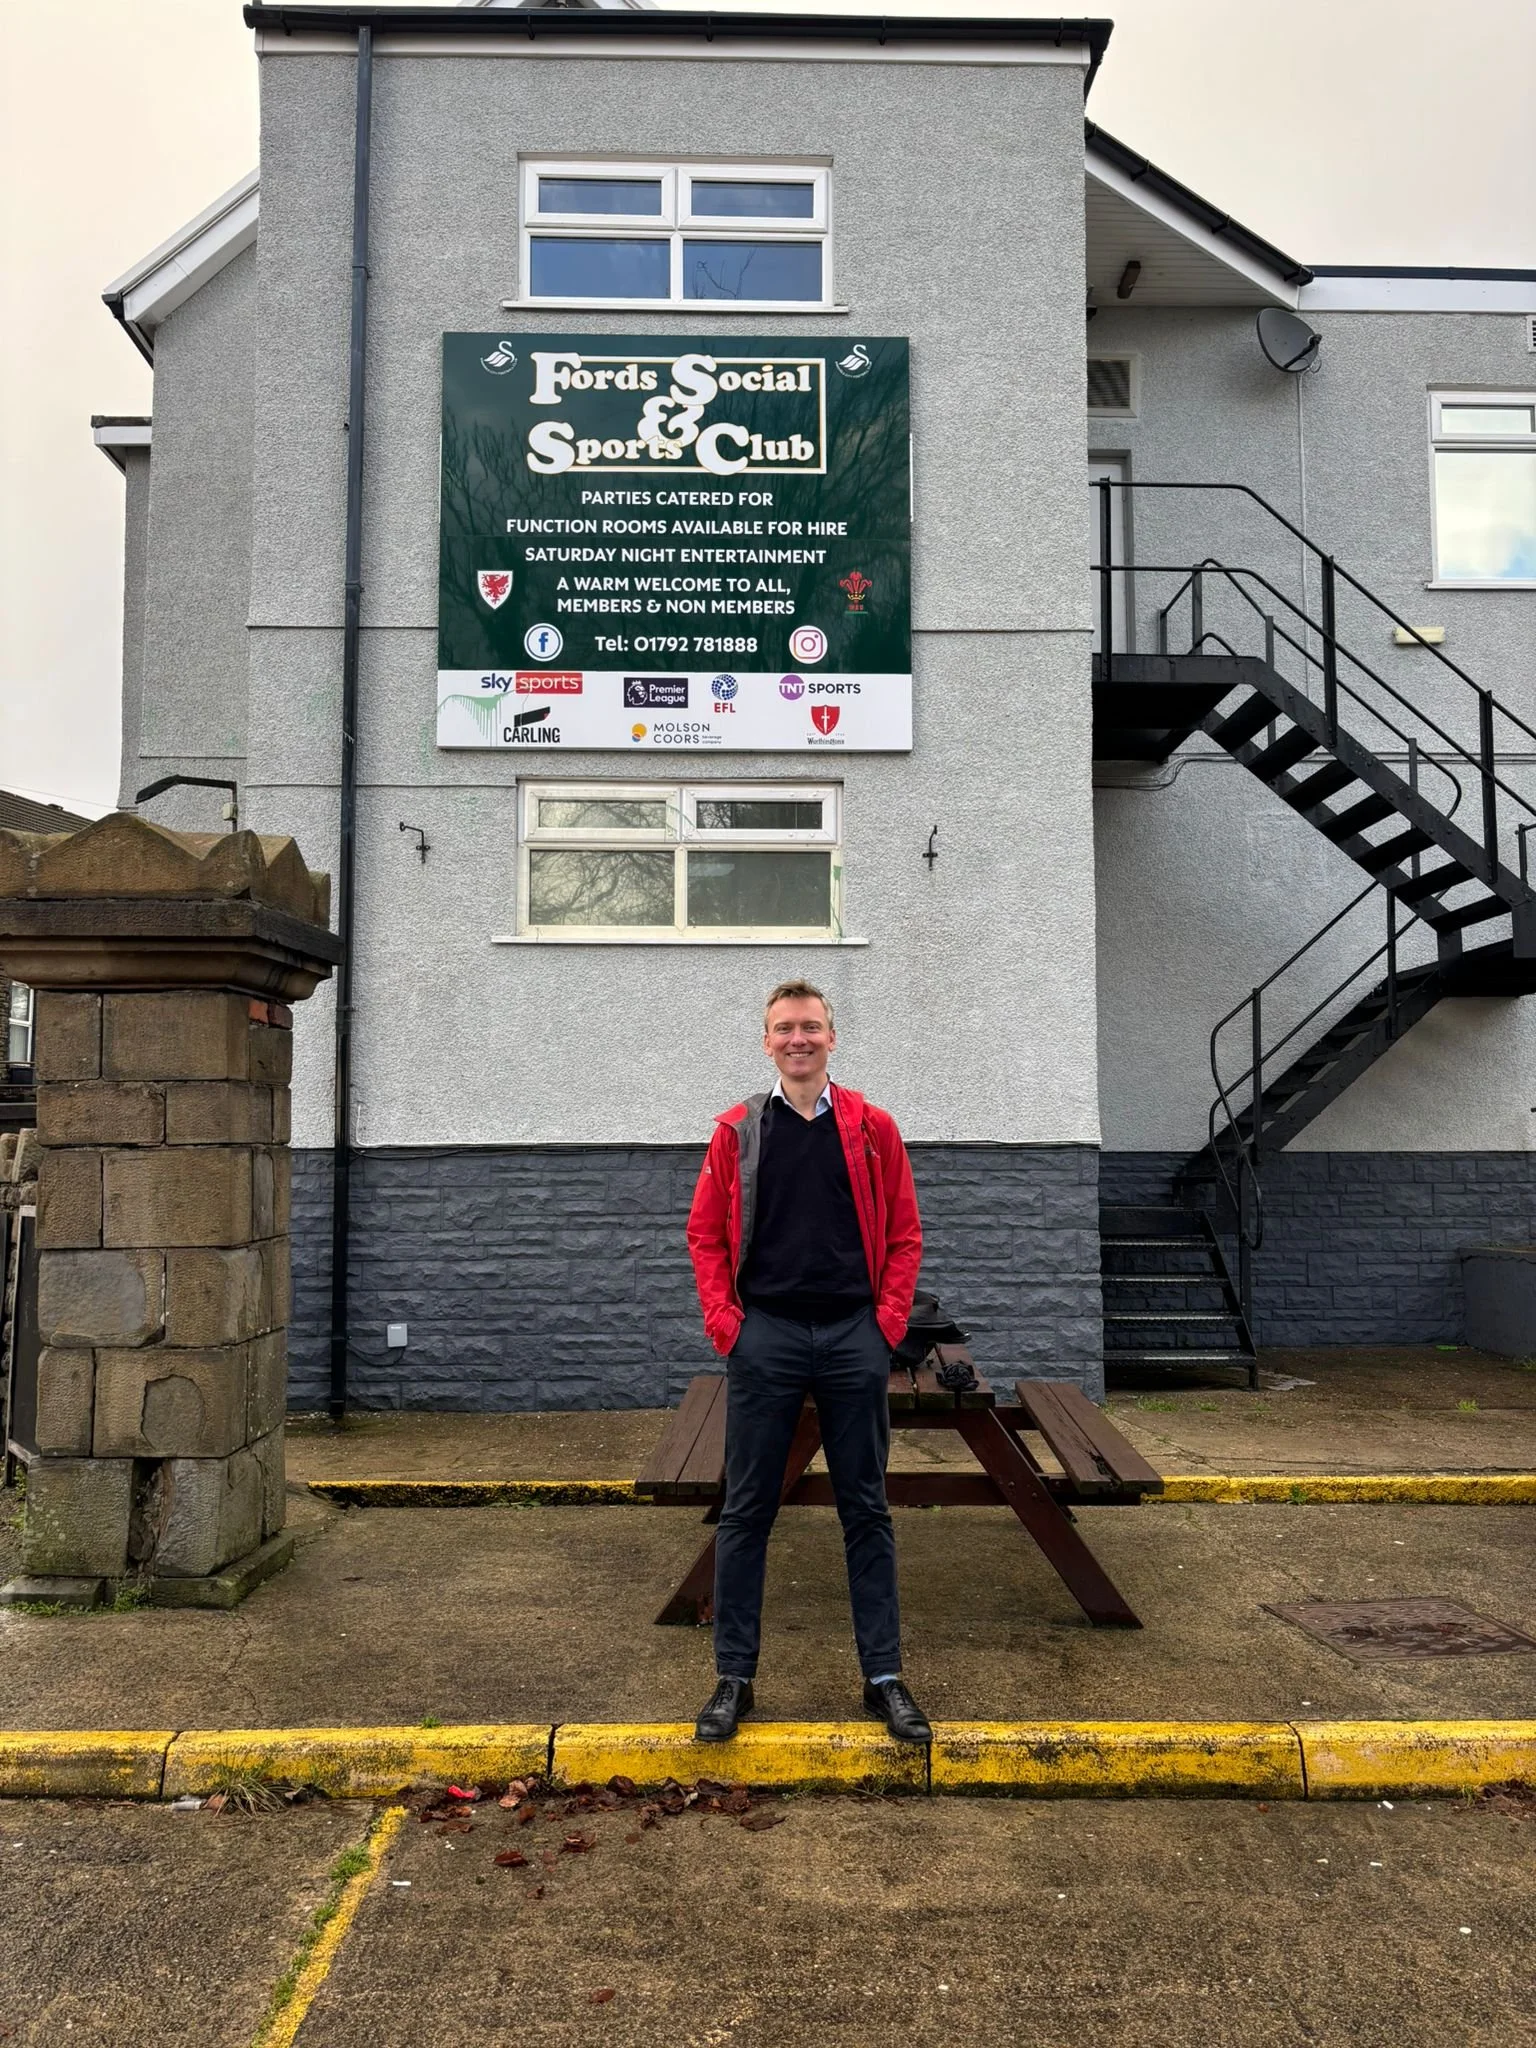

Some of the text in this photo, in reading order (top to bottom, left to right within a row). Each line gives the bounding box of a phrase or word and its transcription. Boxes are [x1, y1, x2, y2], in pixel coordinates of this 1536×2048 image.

[529, 352, 812, 406] Fords Social
[637, 395, 705, 448] &
[527, 421, 815, 476] Sports Club
[581, 490, 774, 506] PARTIES CATERED FOR
[506, 518, 848, 536] FUNCTION ROOMS AVAILABLE FOR HIRE
[525, 547, 827, 564] SATURDAY NIGHT ENTERTAINMENT
[556, 576, 791, 595] A WARM WELCOME TO ALL,
[557, 599, 795, 615] MEMBERS & NON MEMBERS
[594, 635, 758, 652] Tel: 01792 781888
[481, 673, 579, 692] sky sports
[649, 684, 685, 694] Premier
[780, 683, 861, 694] TNT SPORTS
[649, 694, 686, 704] League
[714, 702, 736, 713] EFL
[503, 727, 560, 743] CARLING
[653, 723, 710, 732] MOLSON
[653, 734, 700, 744] COORS
